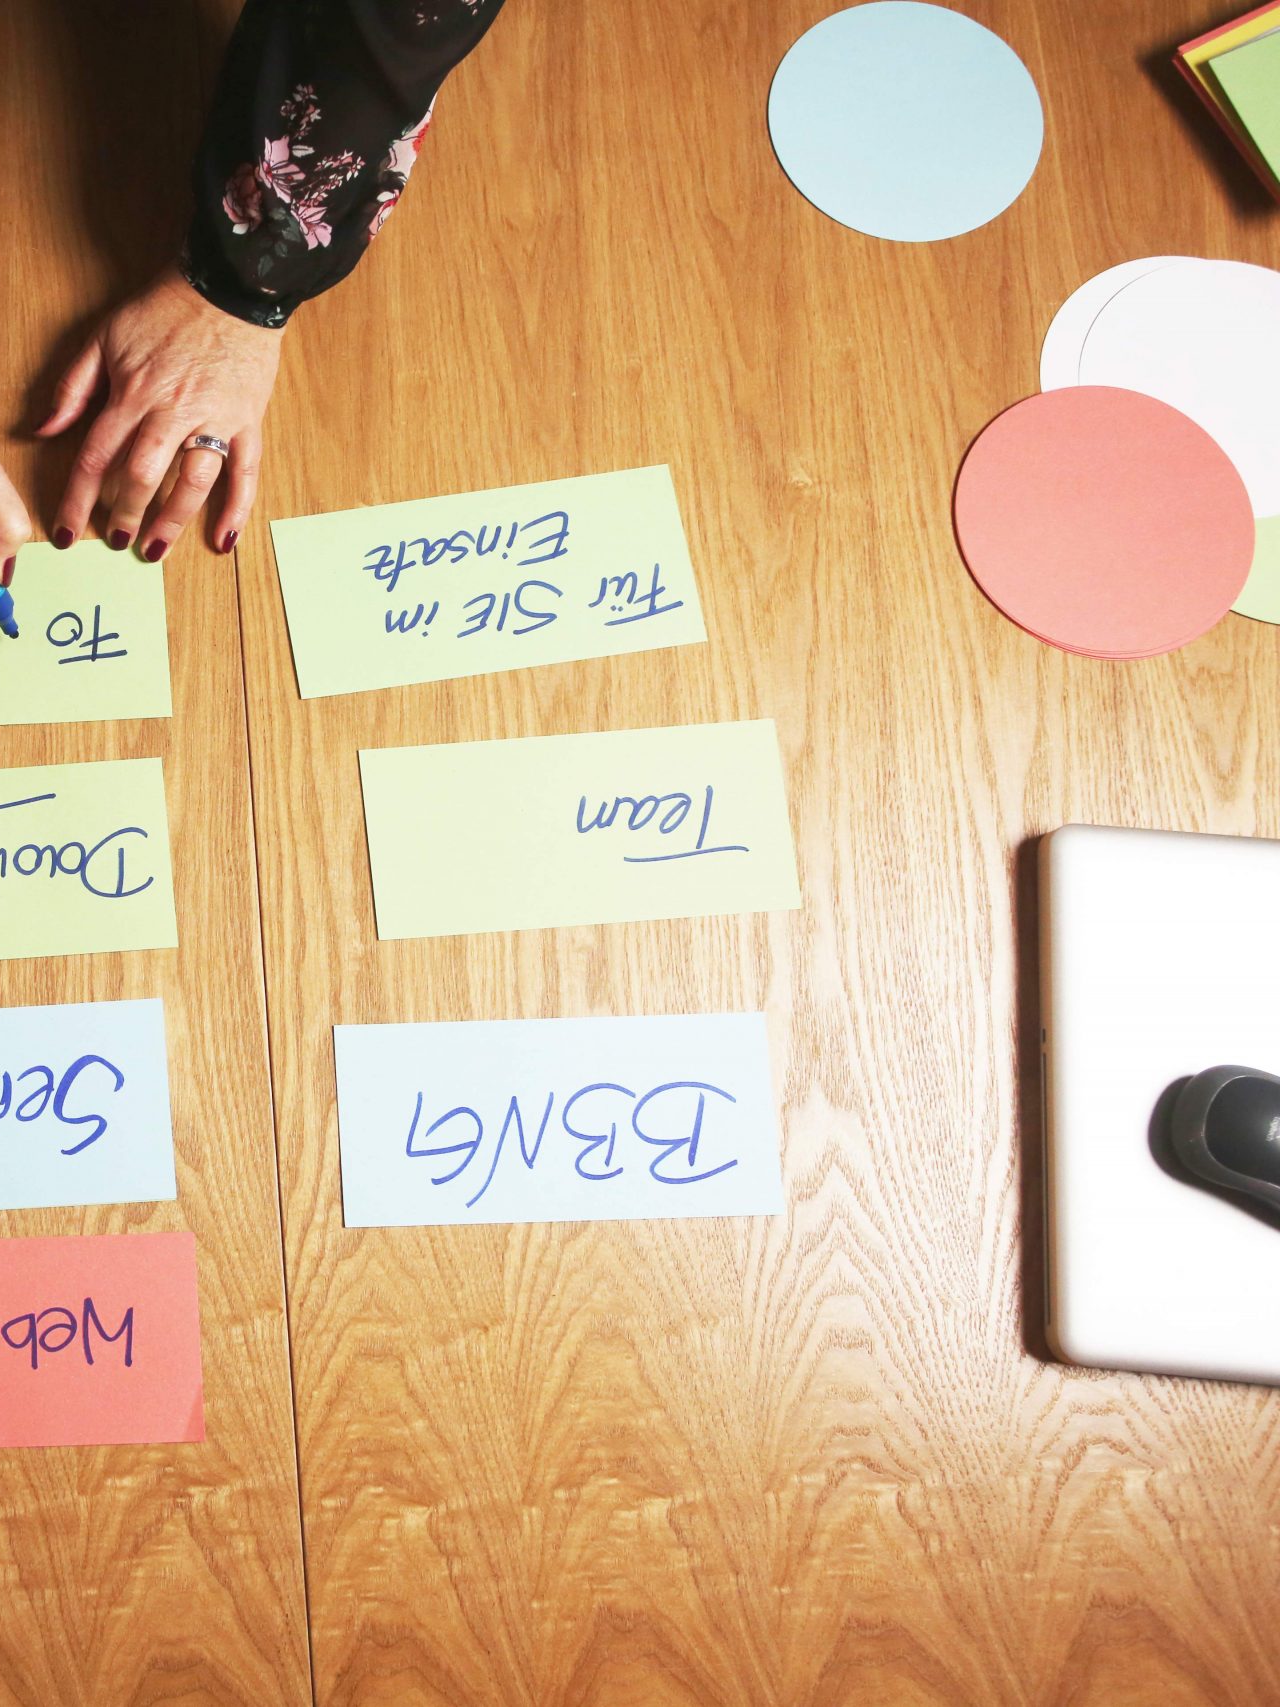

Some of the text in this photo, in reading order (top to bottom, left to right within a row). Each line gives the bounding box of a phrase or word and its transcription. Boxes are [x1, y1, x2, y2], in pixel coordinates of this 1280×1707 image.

[362, 510, 571, 594] Einsatz
[384, 562, 685, 639] Für SIE im
[576, 784, 750, 864] Team
[404, 1081, 740, 1210] BBNG
